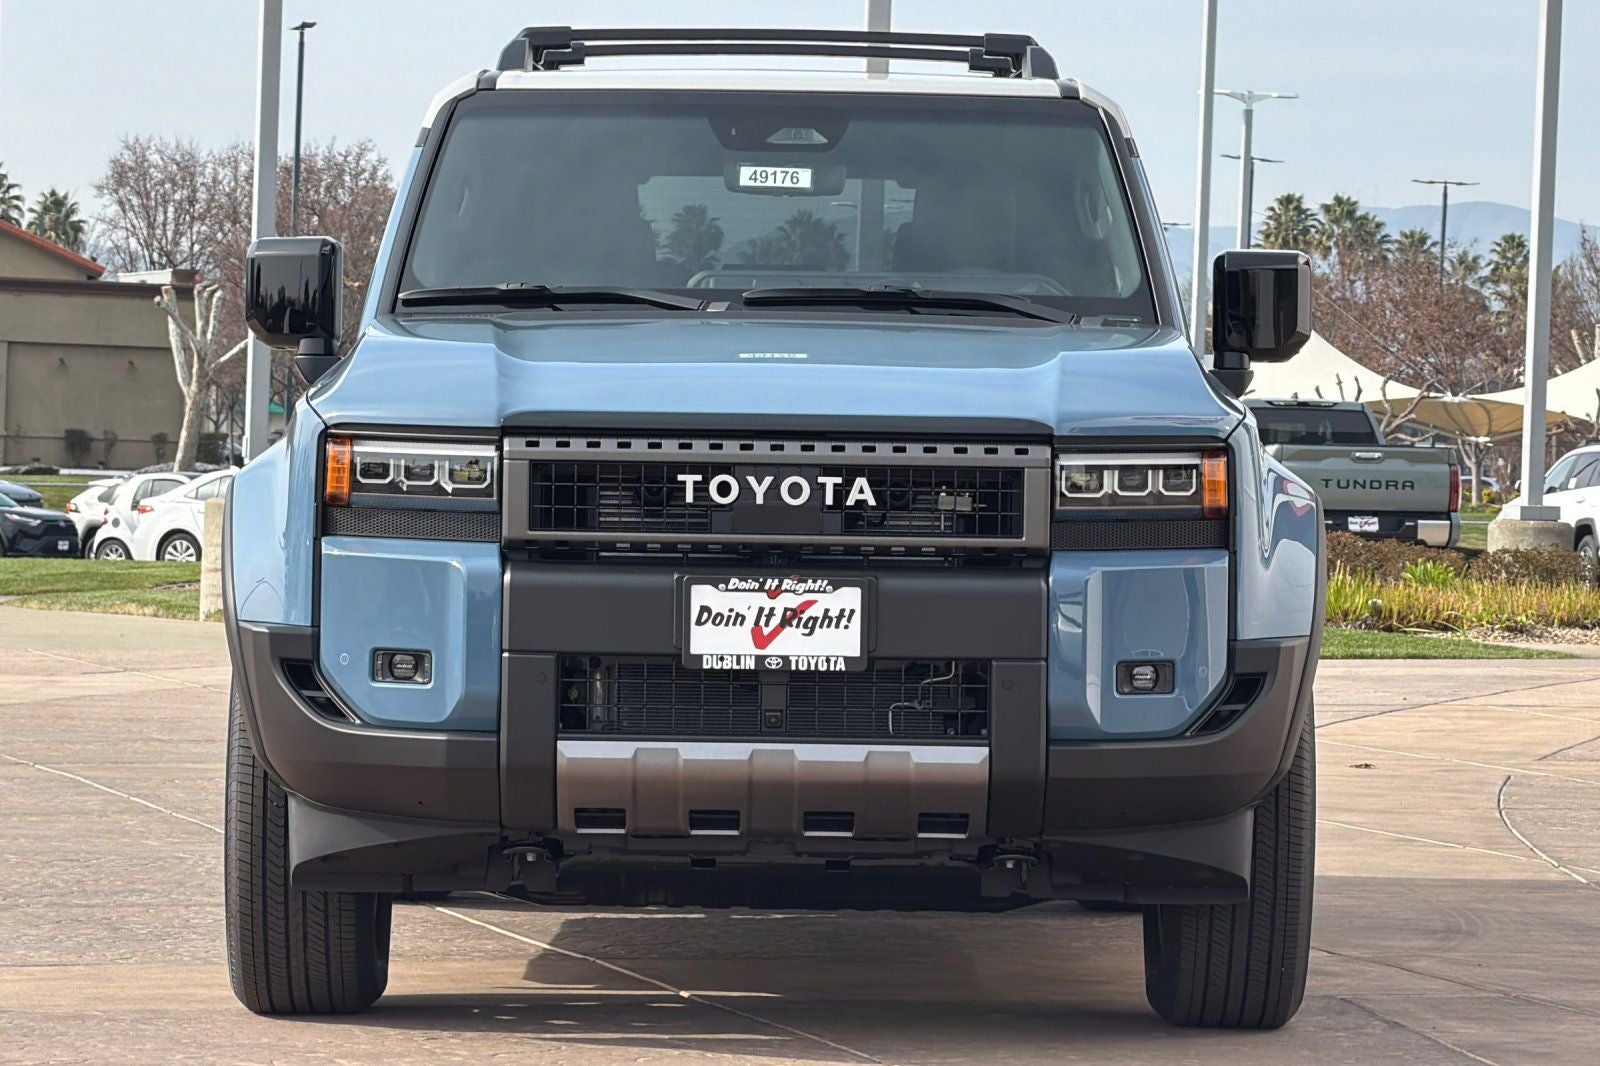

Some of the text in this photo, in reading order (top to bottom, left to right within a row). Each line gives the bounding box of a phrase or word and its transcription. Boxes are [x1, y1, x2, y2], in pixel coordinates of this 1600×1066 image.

[748, 169, 800, 185] 49176
[677, 474, 876, 506] TOYOTA
[1321, 478, 1415, 491] TUNDRA
[728, 578, 828, 594] Doin' It Right!
[695, 605, 856, 637] Doin' It Right!
[702, 655, 846, 671] DUBLIN TOYOTA
